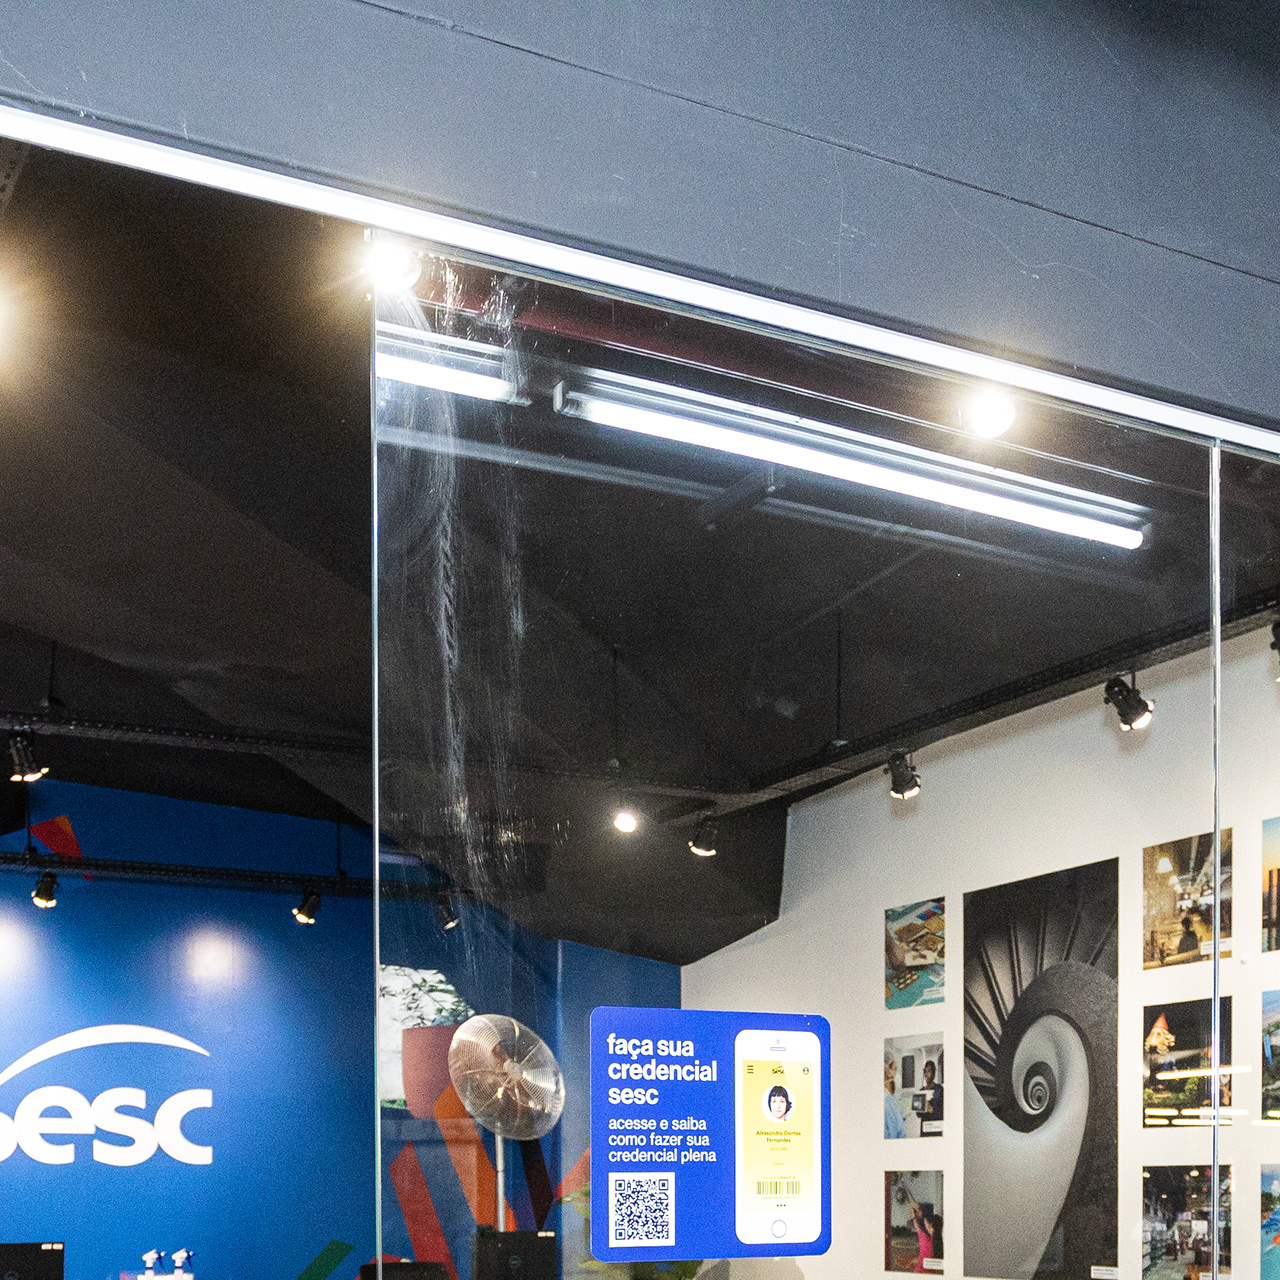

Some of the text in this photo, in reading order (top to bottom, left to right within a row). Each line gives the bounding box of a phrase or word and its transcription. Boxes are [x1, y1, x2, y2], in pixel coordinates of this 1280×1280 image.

[606, 1032, 694, 1060] faça sua
[608, 1059, 718, 1082] credencial
[608, 1087, 659, 1105] sesc
[608, 1116, 707, 1131] acesse e saiba
[608, 1132, 710, 1146] como fazer sua
[608, 1148, 717, 1165] credencial plena
